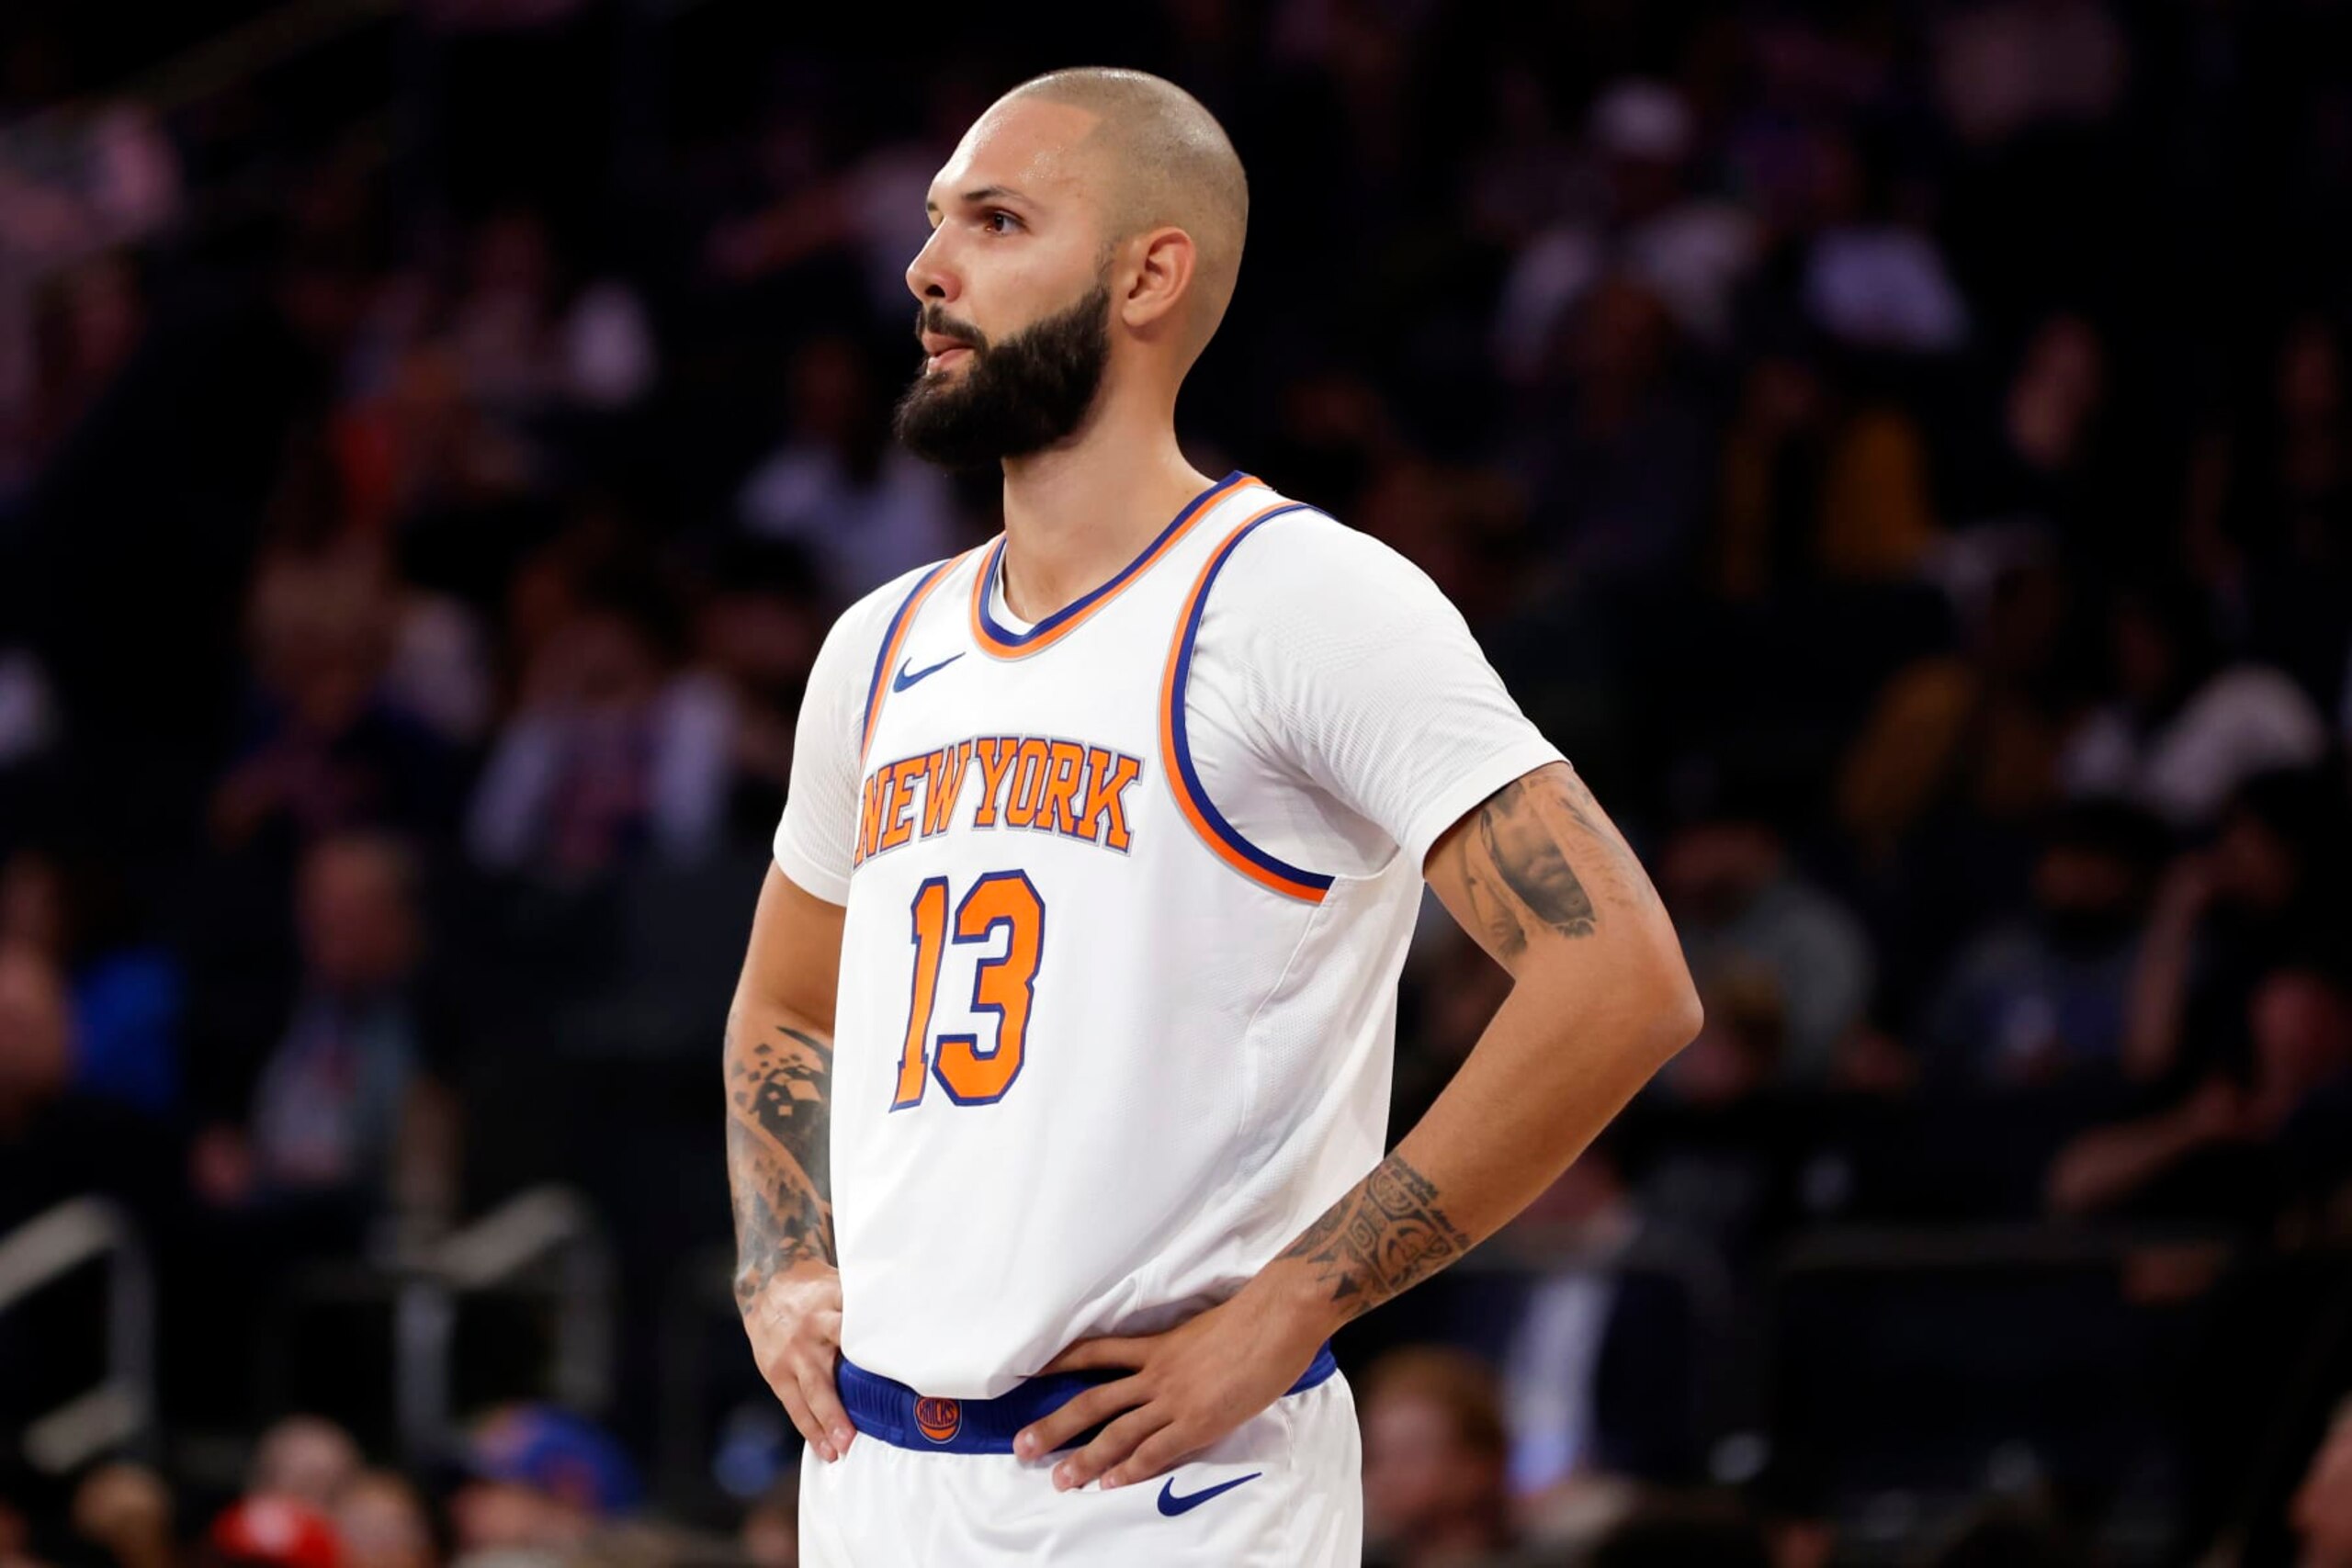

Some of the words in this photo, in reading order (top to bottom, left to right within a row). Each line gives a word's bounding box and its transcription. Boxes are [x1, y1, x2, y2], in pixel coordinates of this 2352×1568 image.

[854, 739, 970, 869] NEW
[971, 733, 1145, 857] YORK
[888, 868, 1046, 1113] 13
[918, 1399, 956, 1426] KNICKS
